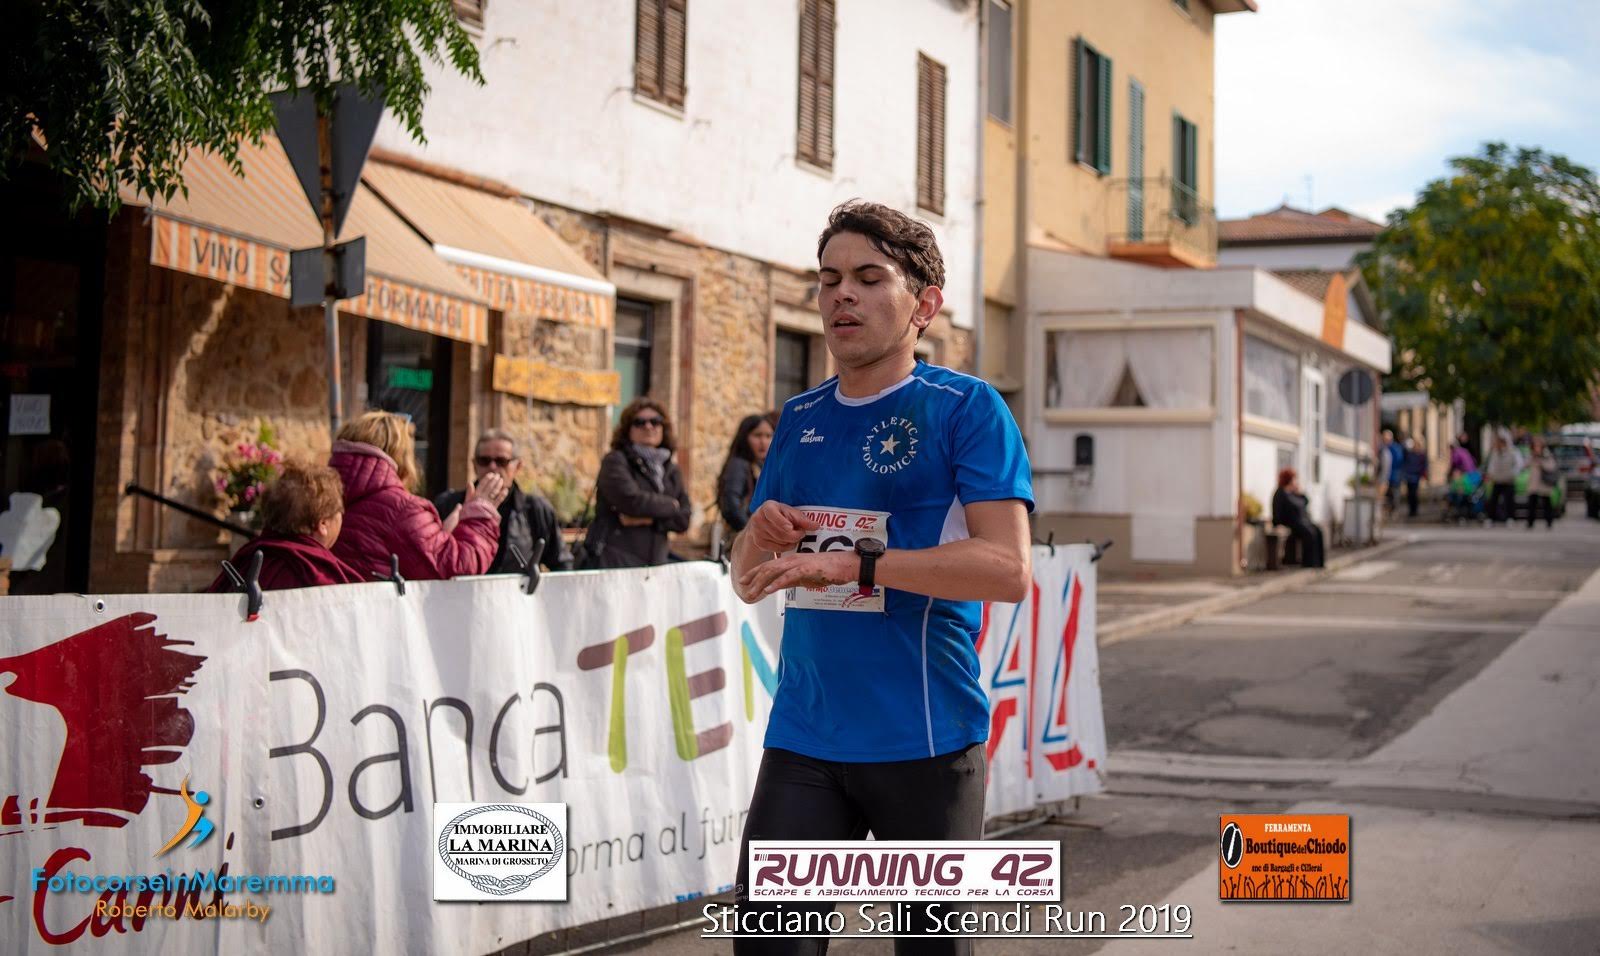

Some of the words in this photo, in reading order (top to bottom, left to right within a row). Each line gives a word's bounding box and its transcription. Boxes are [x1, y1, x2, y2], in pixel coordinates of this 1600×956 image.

[193, 238, 249, 275] VINO
[866, 416, 919, 446] ATLETICA
[862, 446, 917, 474] FOLLONICA
[658, 811, 689, 856] al
